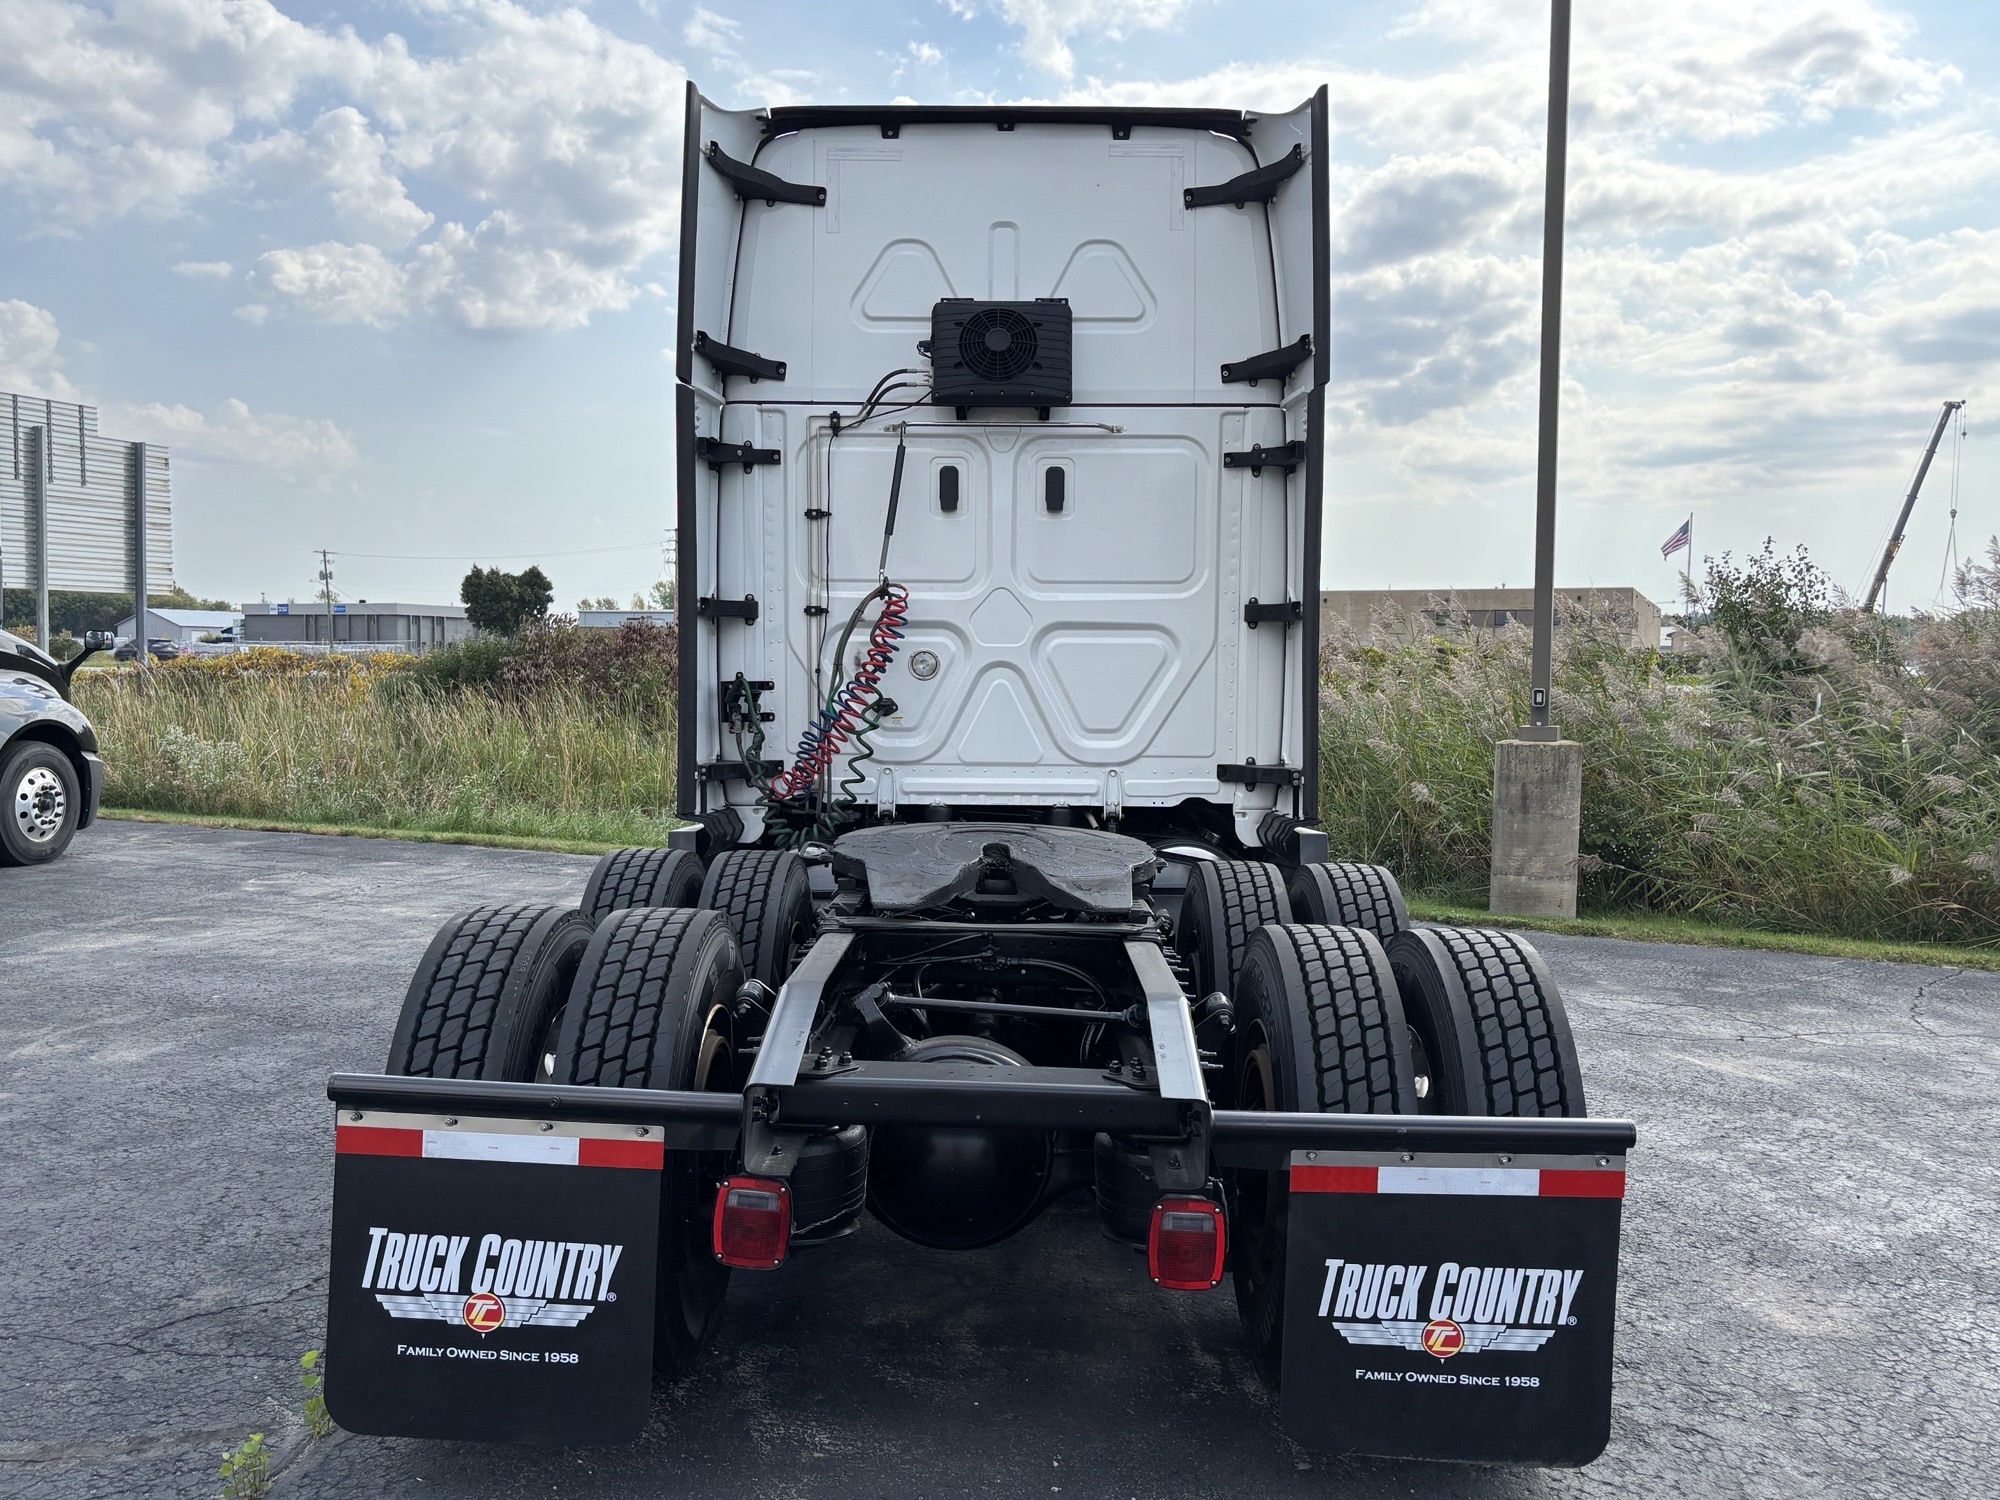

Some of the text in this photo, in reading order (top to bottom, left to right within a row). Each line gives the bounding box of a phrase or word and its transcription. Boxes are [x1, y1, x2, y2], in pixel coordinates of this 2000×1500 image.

[361, 1226, 624, 1302] TRUCK COUNTRY
[1317, 1258, 1584, 1326] TRUCK COUNTRY
[397, 1344, 579, 1364] FAMILY OWNED SINCE 1958
[1355, 1369, 1540, 1388] FAMILY OWNED SINCE 1958
